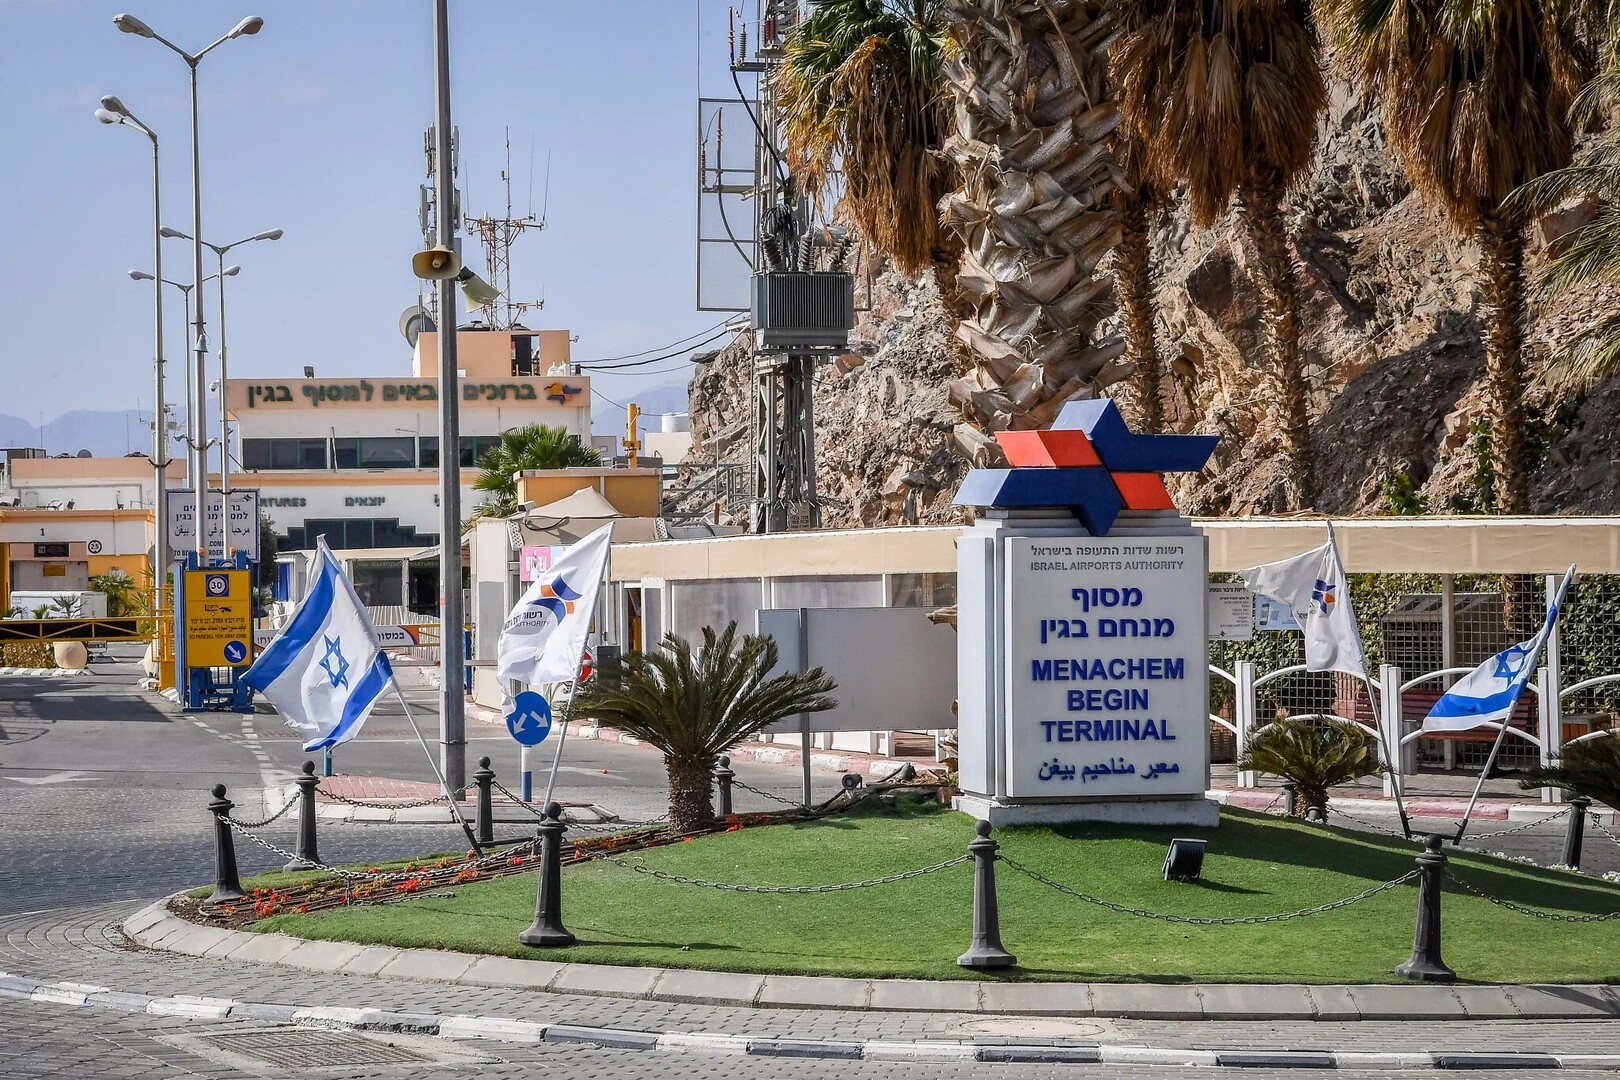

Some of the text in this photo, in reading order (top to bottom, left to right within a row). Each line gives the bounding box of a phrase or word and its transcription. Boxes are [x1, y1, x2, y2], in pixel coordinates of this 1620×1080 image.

[248, 378, 537, 408] ברוכים באים למסוף בגין
[259, 497, 306, 507] RTURES
[345, 496, 385, 507] יוצאים
[40, 528, 45, 536] 1
[1031, 545, 1184, 556] רשות שדות התעופה בישראל
[1030, 560, 1184, 571] ISRAEL AIRPORTS AUTHORITY
[211, 581, 222, 589] 30
[1071, 587, 1143, 612] מסוף
[1040, 618, 1175, 644] מנחם בגין
[1031, 658, 1184, 681] MENACHEM
[1067, 688, 1149, 711] BEGIN
[1040, 719, 1176, 742] TERMINAL
[1038, 757, 1180, 784] معبر مناحيم بيغن
